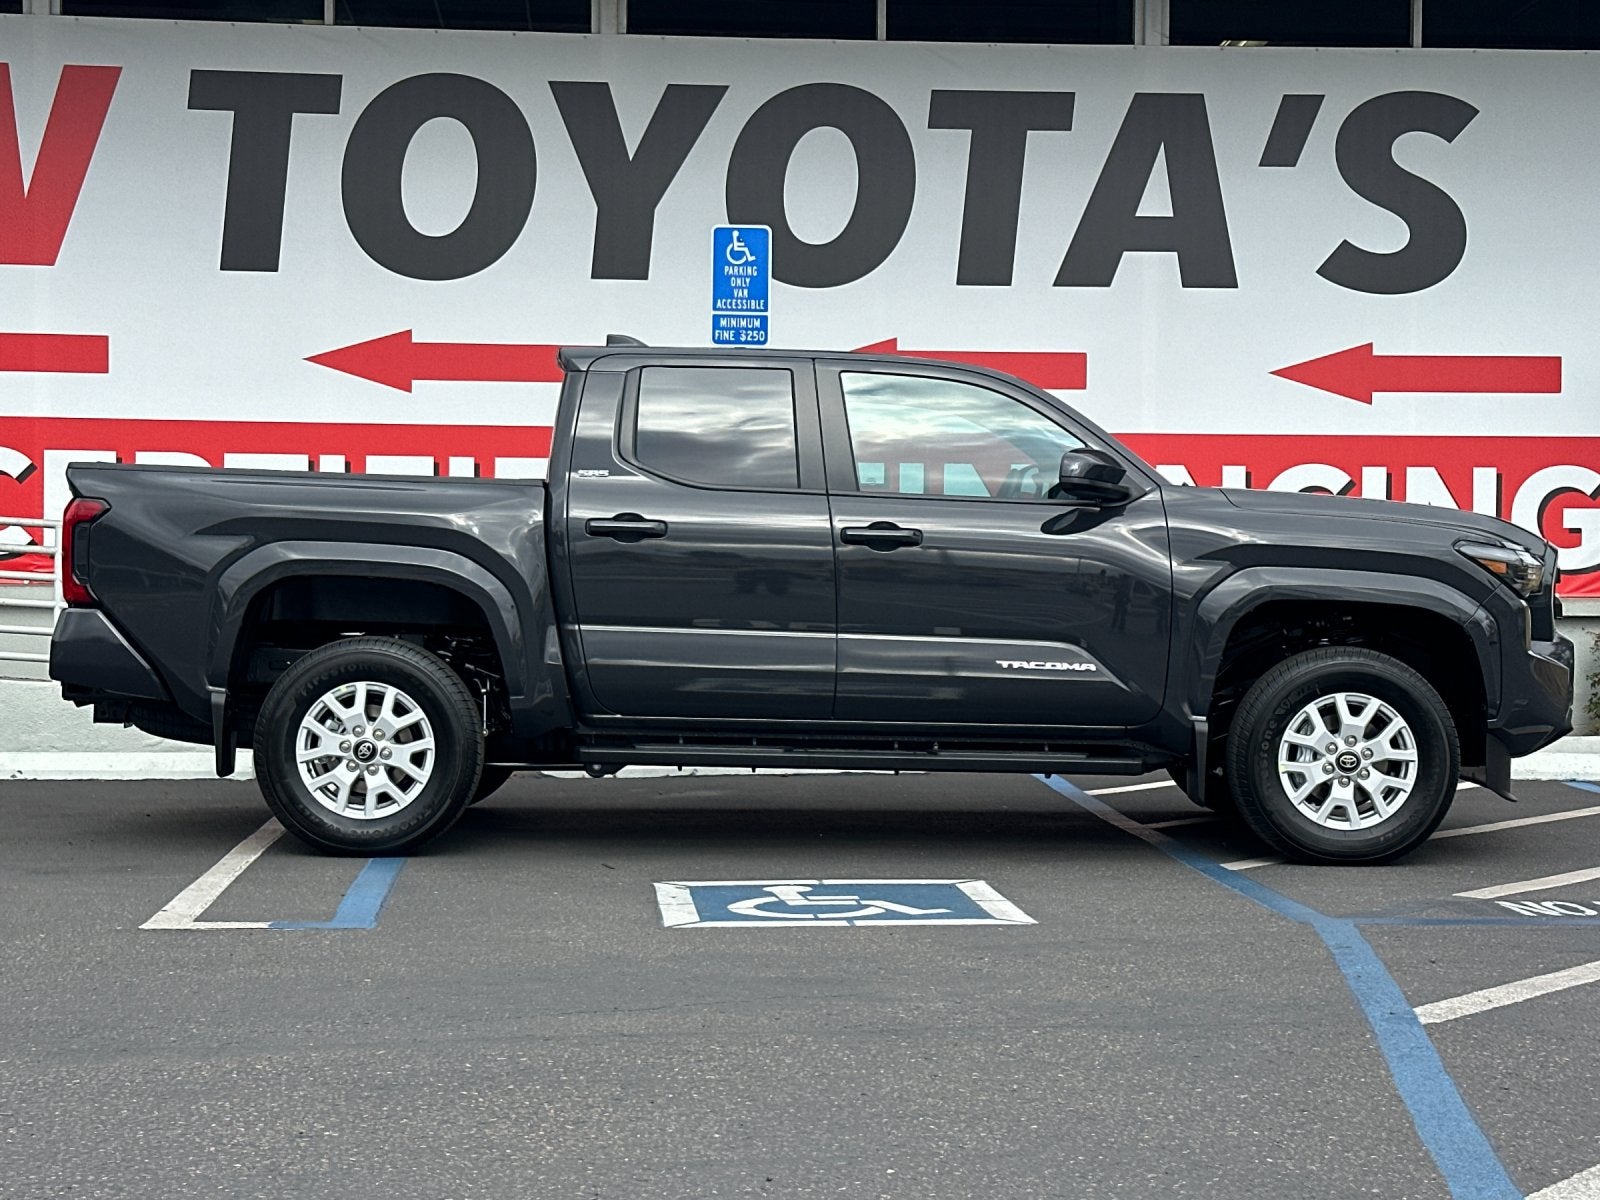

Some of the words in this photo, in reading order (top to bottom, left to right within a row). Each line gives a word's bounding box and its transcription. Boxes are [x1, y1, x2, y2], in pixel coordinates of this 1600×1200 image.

[188, 70, 1480, 295] TOYOTA'S
[724, 265, 758, 276] PARKING
[730, 277, 751, 287] ONLY
[733, 288, 749, 298] VAN
[716, 299, 765, 310] ACCESSIBLE
[720, 317, 761, 328] MINIMUM
[715, 330, 735, 341] FINE
[739, 330, 765, 342] $250
[995, 660, 1097, 672] TACOMA
[1494, 900, 1598, 917] NO
